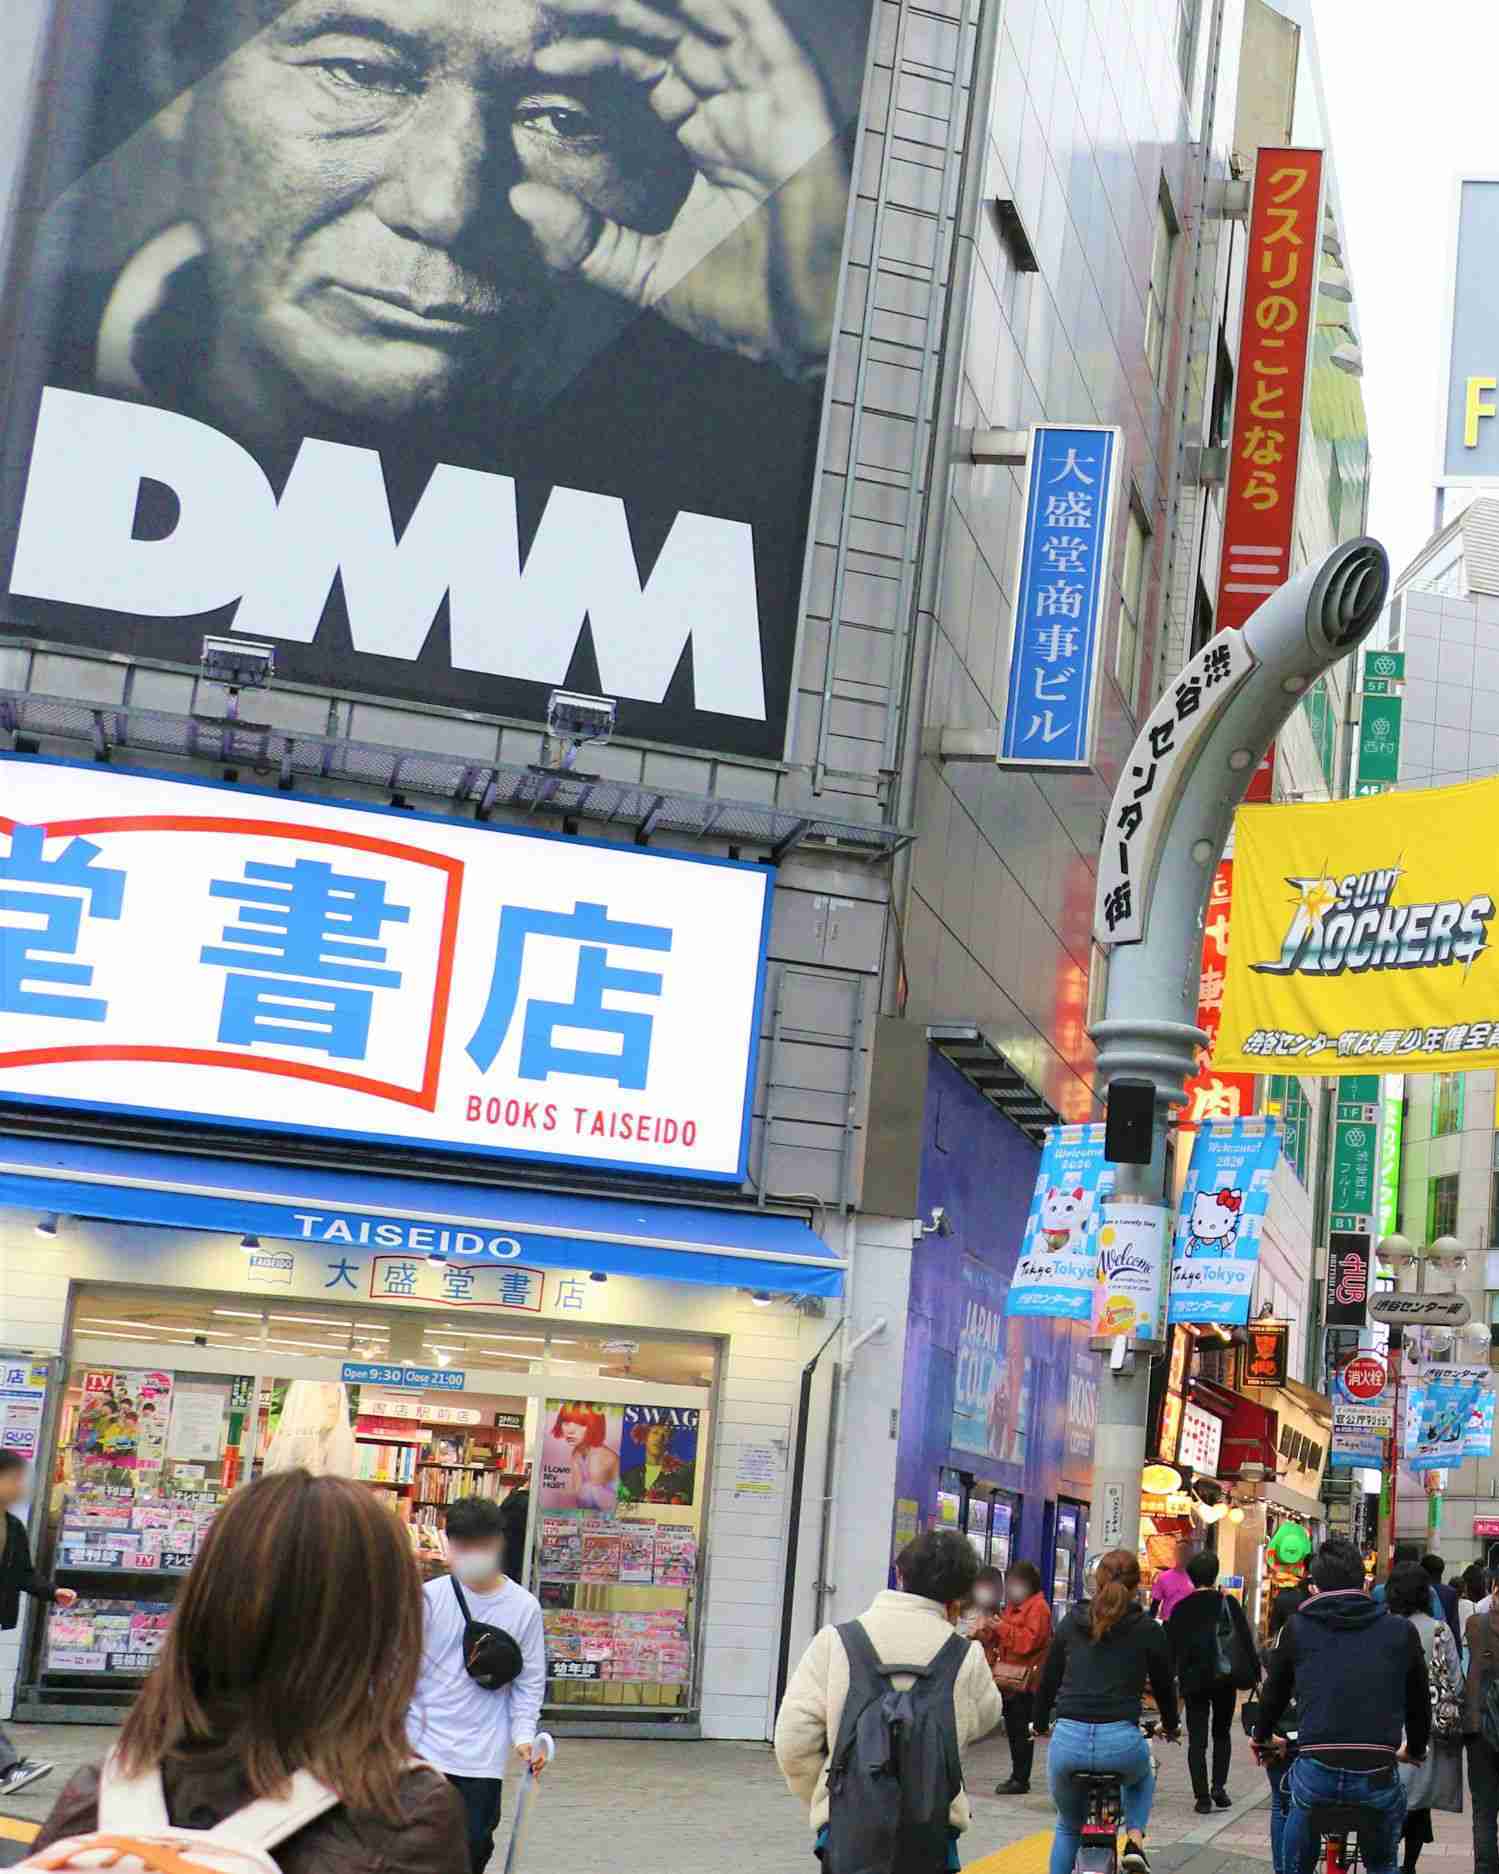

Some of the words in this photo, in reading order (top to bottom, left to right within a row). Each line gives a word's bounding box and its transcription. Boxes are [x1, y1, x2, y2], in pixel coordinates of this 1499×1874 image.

[1240, 166, 1307, 510] クスリのことなら
[9, 385, 767, 722] DMM
[1021, 447, 1096, 744] 大盛堂商事ビル
[1103, 643, 1232, 933] 渋谷センター街
[1335, 868, 1398, 907] SUN
[1249, 878, 1497, 976] ROCKERS
[466, 1094, 558, 1132] BOOKS
[574, 1108, 697, 1149] TAISEIDO
[293, 1213, 522, 1259] TAISEIDO
[323, 1257, 587, 1312] 大盛堂書店
[1053, 1260, 1095, 1280] Tokyo
[1202, 1265, 1246, 1285] Tokyo
[369, 1367, 401, 1382] 9:30
[406, 1368, 431, 1382] Close
[431, 1372, 463, 1386] 21:00
[1347, 1370, 1383, 1387] 消火栓
[6, 1431, 34, 1442] QUO
[625, 1406, 699, 1427] SWAG
